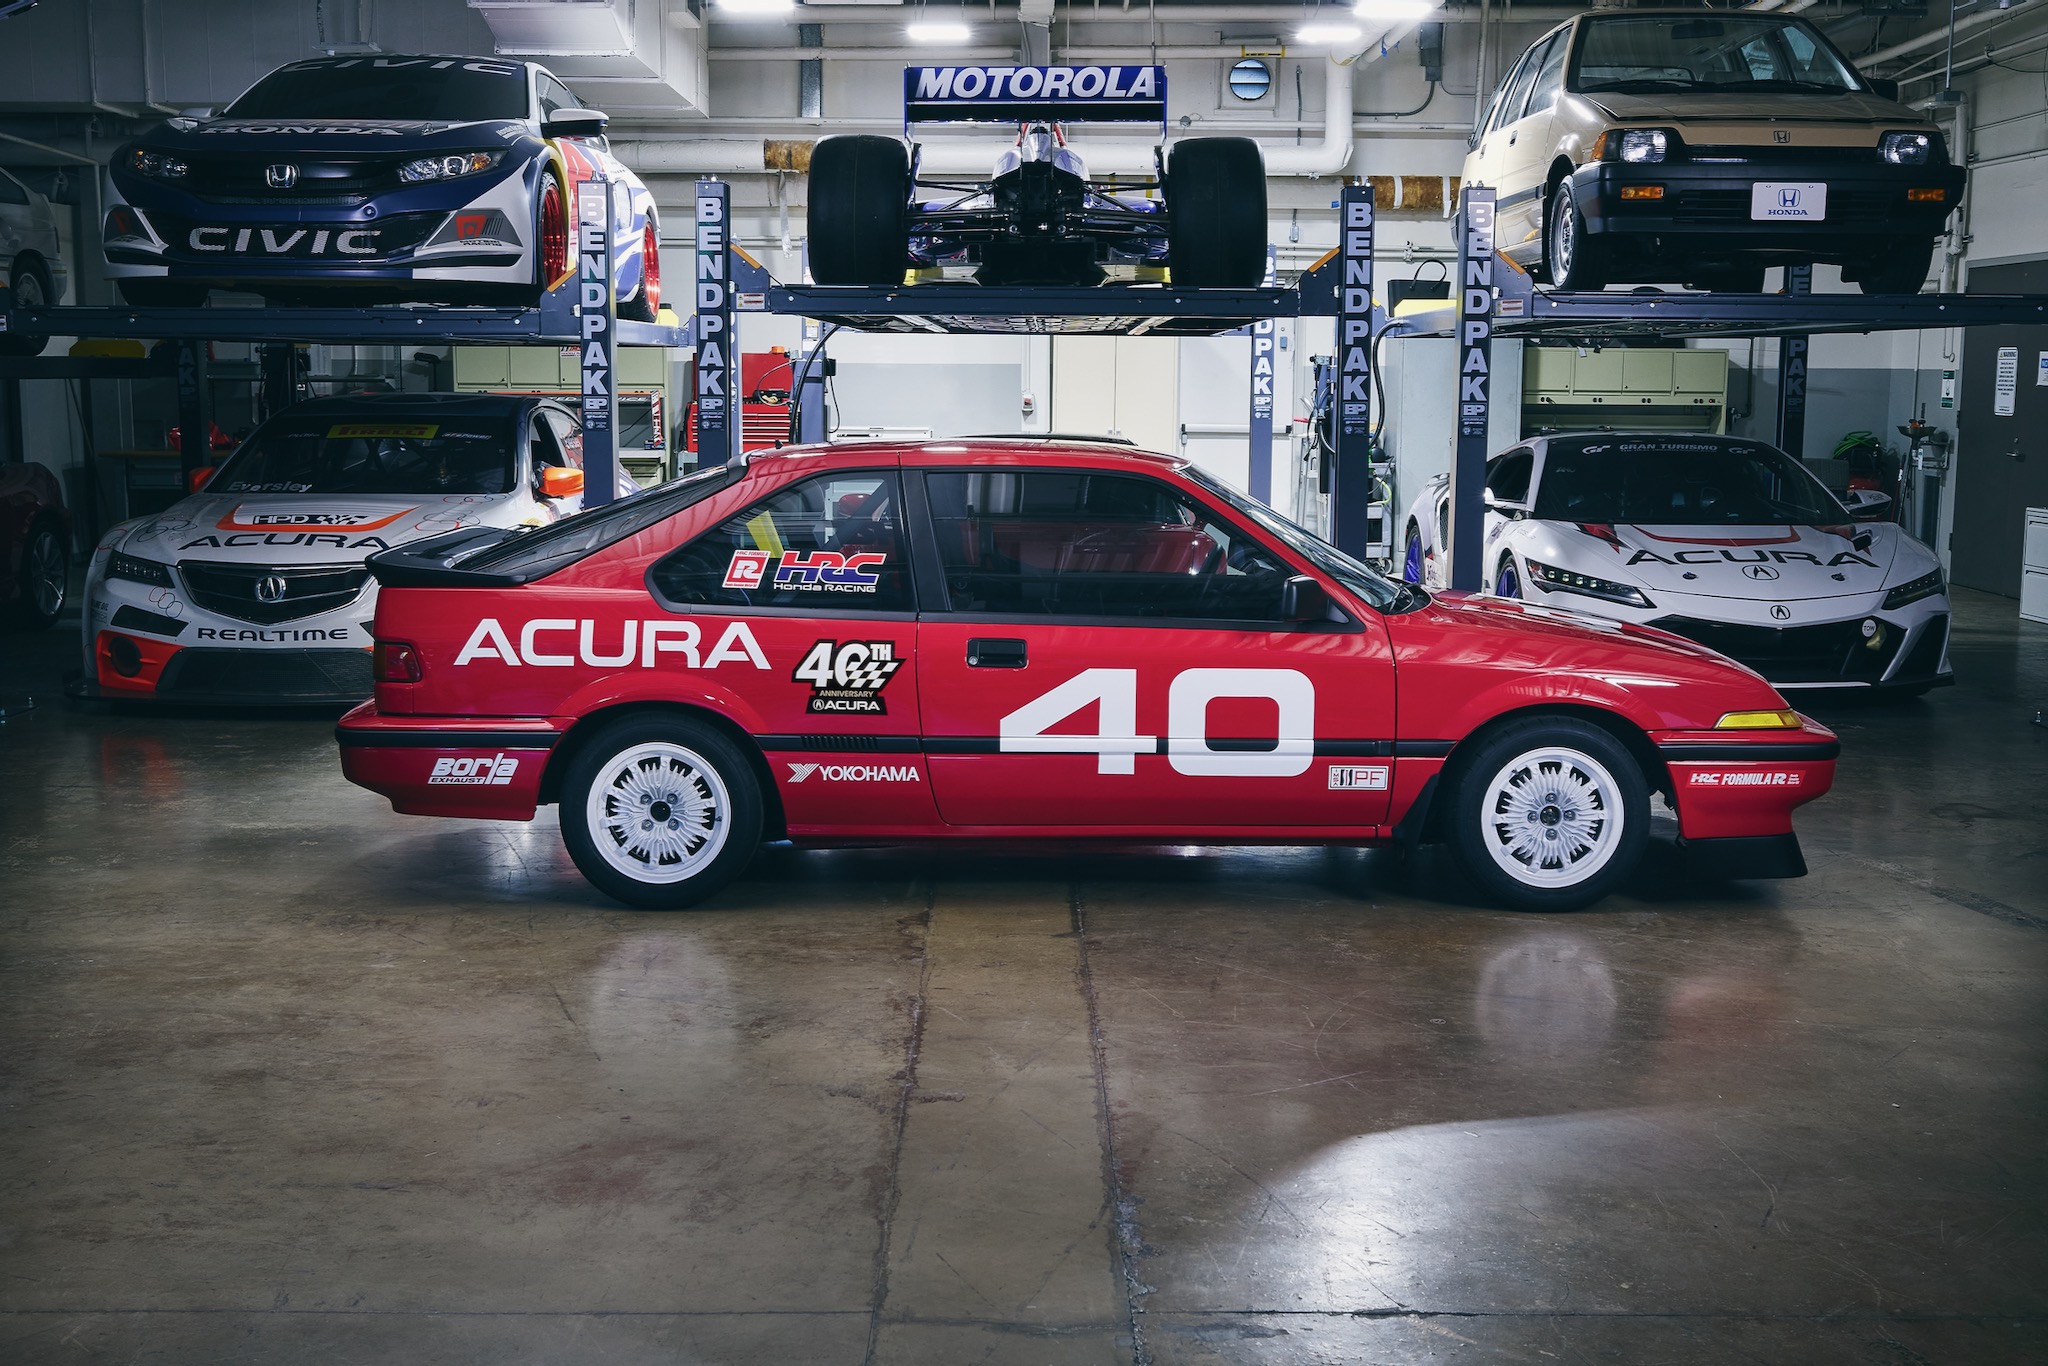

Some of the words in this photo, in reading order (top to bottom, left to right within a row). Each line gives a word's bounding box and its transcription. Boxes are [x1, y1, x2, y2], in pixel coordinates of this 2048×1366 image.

[282, 59, 517, 75] CIVIC
[915, 66, 1156, 98] MOTOROLA
[200, 126, 403, 135] HONDA
[189, 227, 382, 254] CIVIC
[580, 196, 608, 395] BENDPAK
[698, 197, 724, 395] BENDPAK
[1342, 202, 1372, 401] BENDPAK
[1461, 203, 1493, 402] BENDPAK
[585, 399, 606, 409] BP
[701, 399, 723, 409] BP
[1344, 403, 1367, 414] BP
[1463, 404, 1485, 415] BP
[338, 425, 429, 436] PIRELLI
[1660, 443, 1718, 451] TURISMO
[227, 481, 312, 493] Eversley
[255, 515, 309, 524] HPD
[178, 533, 391, 551] ACURA
[1625, 549, 1881, 568] ACURA
[773, 550, 887, 586] HRC
[773, 583, 822, 591] Honda
[824, 583, 876, 593] RACING
[198, 627, 348, 641] REALTIME
[453, 618, 772, 669] ACURA
[819, 690, 874, 698] ANNIVERSARY
[824, 700, 881, 711] ACURA
[1000, 668, 1315, 777] 40
[819, 765, 920, 782] YOKOHAMA
[1691, 773, 1721, 783] HRC
[1721, 773, 1770, 785] FORMULA
